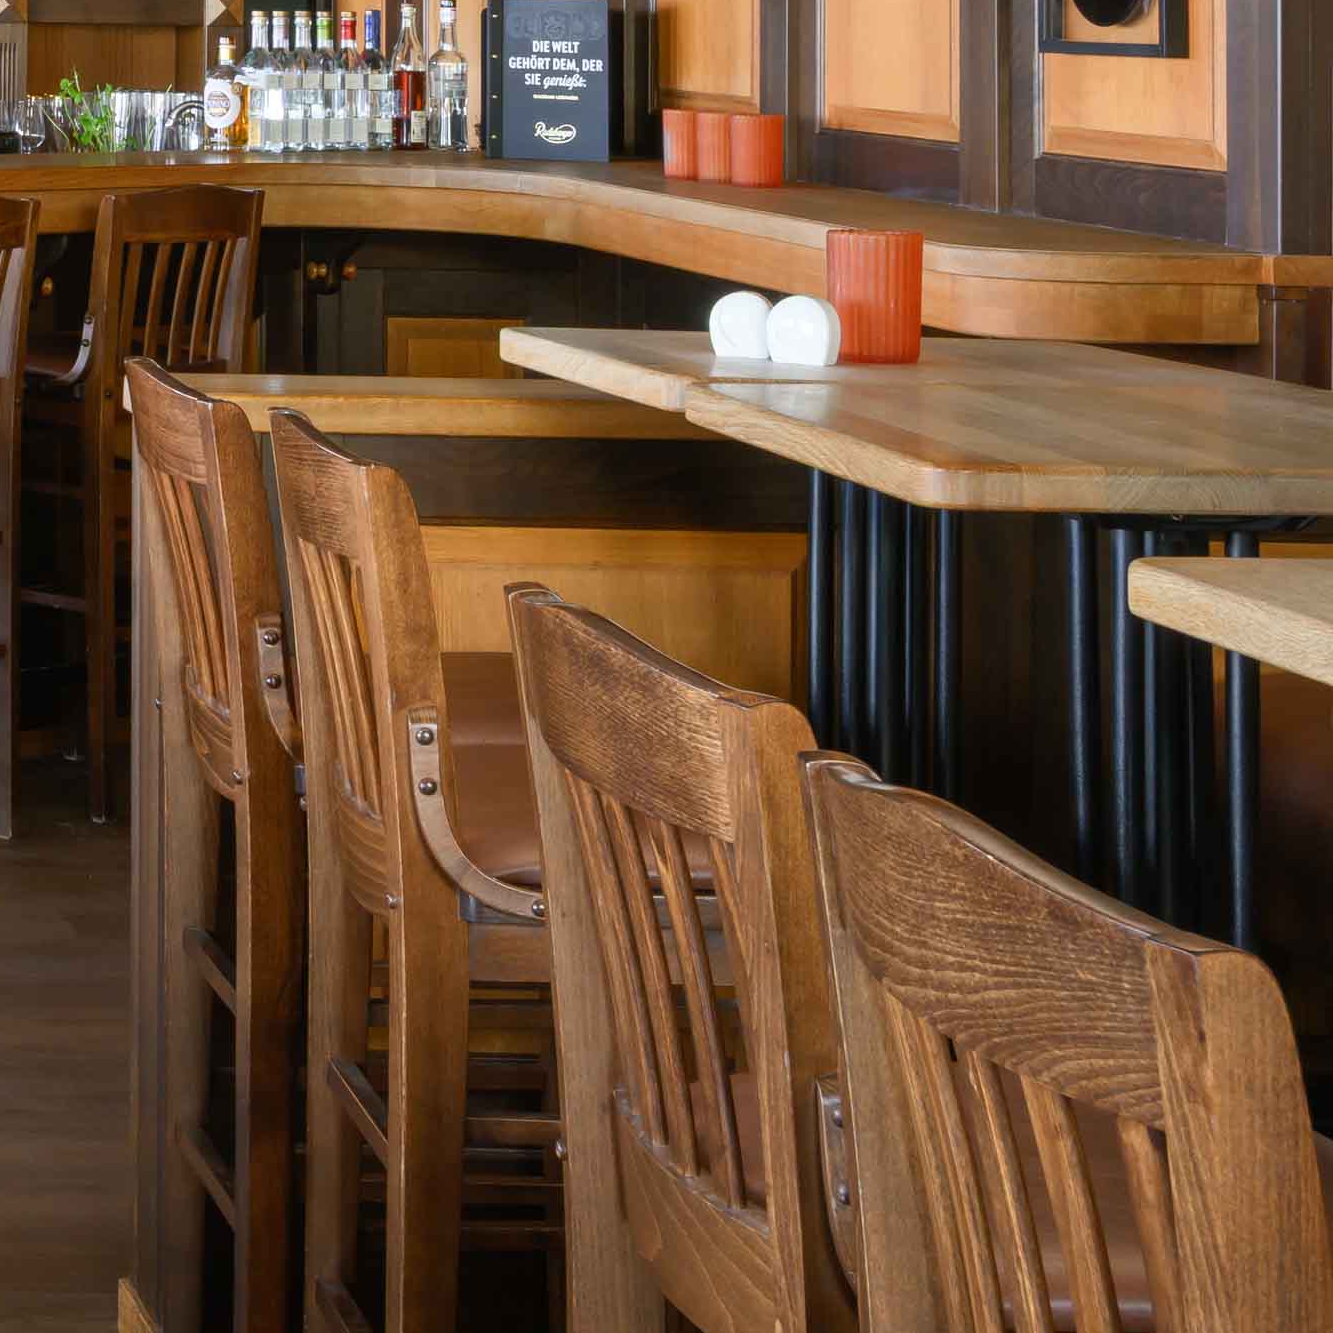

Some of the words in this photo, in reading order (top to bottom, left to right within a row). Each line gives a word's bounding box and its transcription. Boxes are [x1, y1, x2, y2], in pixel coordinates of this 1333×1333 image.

[532, 41, 550, 52] DIE
[552, 41, 580, 53] WELT
[509, 55, 550, 69] GEHÖRT
[553, 58, 579, 72] DEM,
[582, 59, 603, 72] DER
[525, 73, 541, 85] SIE
